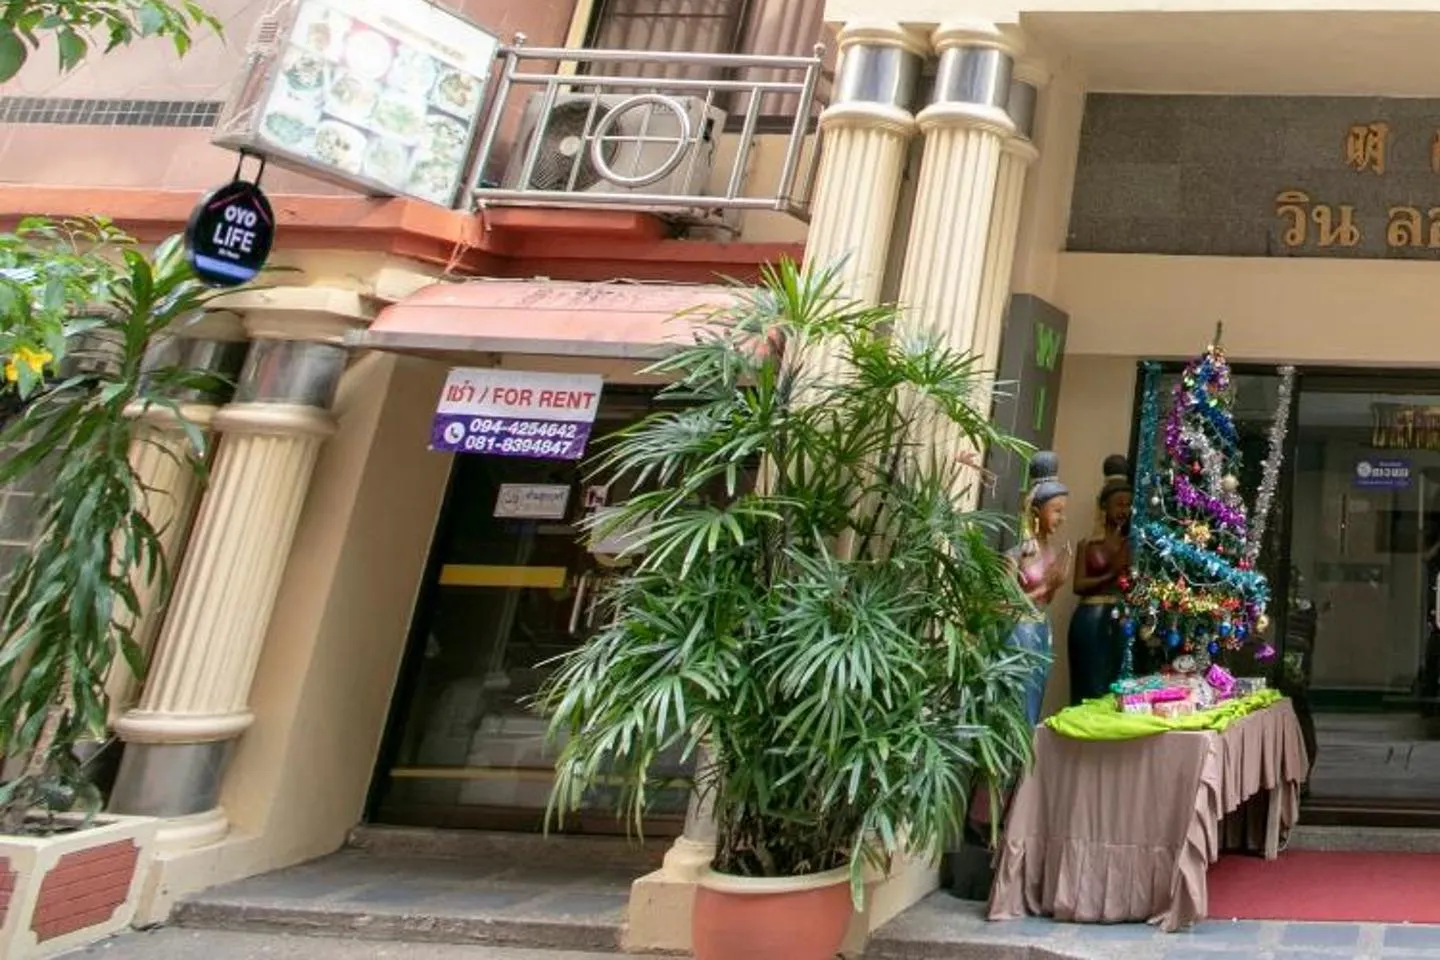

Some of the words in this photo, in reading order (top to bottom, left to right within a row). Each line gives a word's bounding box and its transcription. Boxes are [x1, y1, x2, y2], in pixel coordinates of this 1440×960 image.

[224, 204, 257, 228] OYO
[1276, 190, 1360, 248] วิน
[212, 221, 257, 253] LIFE
[492, 387, 533, 407] FOR
[538, 391, 596, 410] RENT
